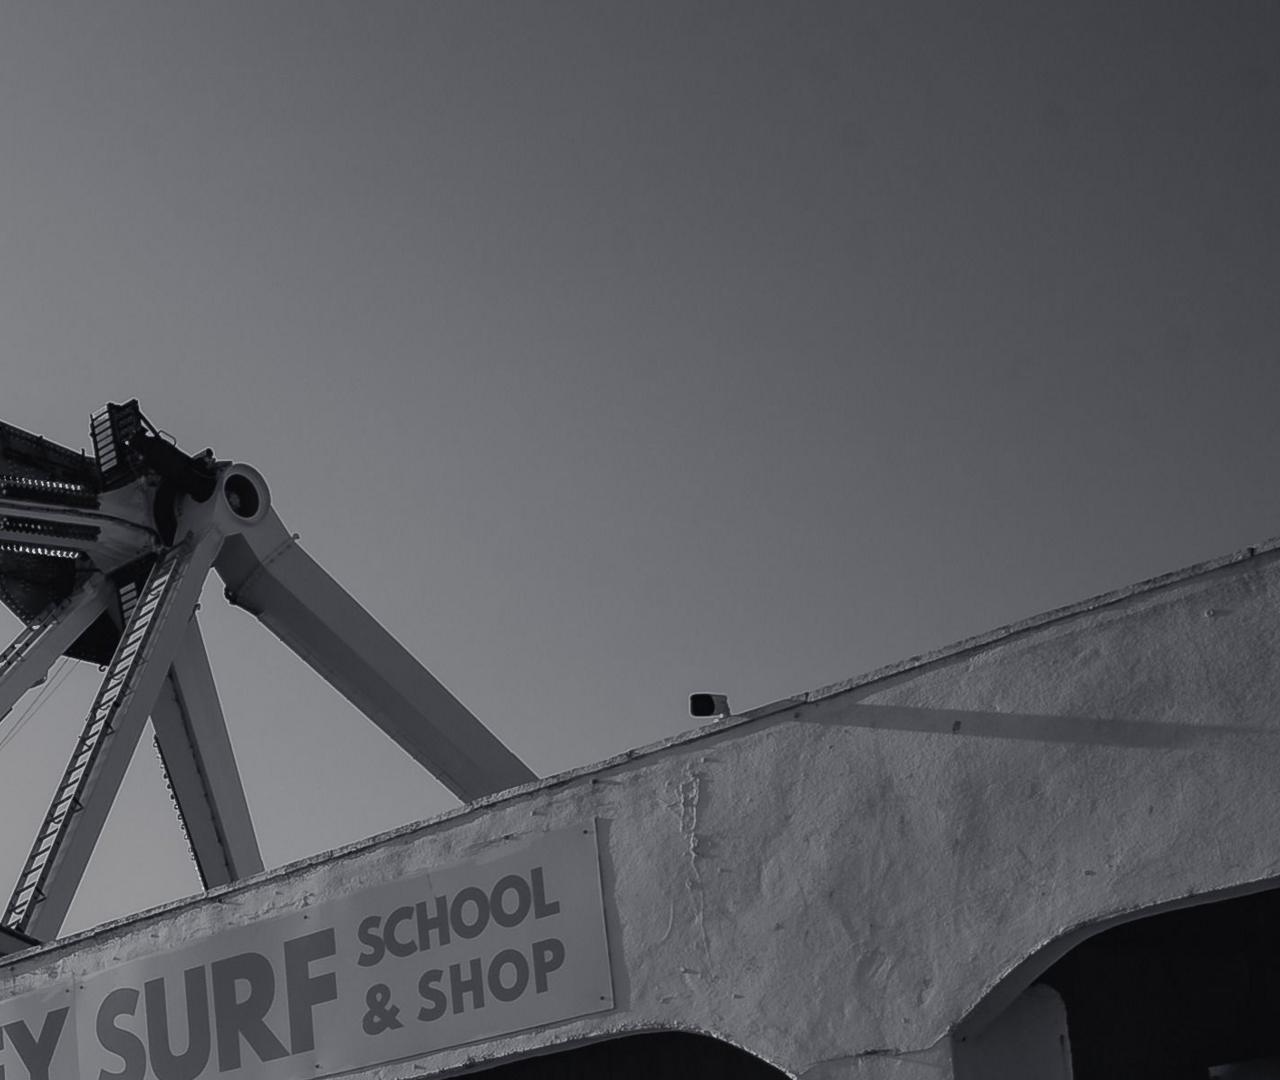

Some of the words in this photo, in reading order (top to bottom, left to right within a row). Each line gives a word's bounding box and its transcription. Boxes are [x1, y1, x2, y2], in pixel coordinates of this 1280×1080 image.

[356, 866, 561, 968] SCHOOL
[361, 982, 405, 1036] &
[416, 937, 566, 1023] SHOP
